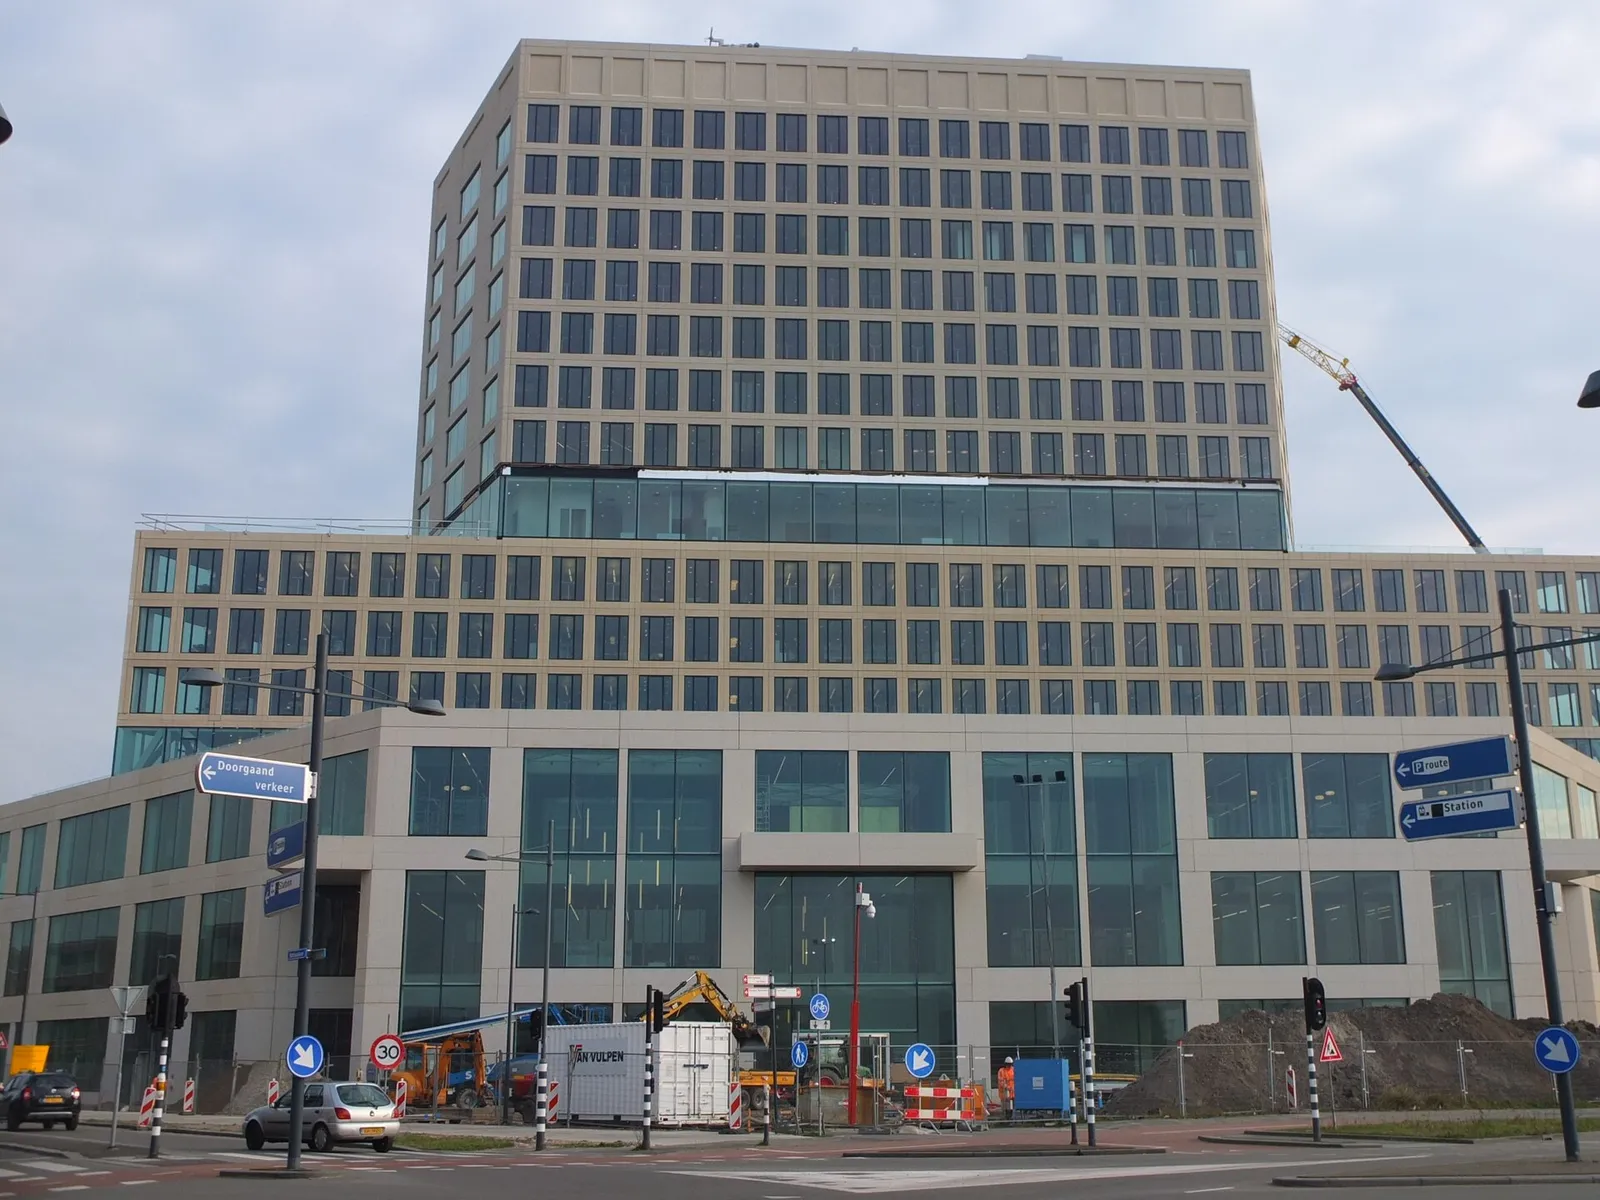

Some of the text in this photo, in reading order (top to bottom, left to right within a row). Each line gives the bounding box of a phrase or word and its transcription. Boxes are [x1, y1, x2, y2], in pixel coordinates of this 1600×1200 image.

[217, 760, 275, 777] Doorgaand
[1425, 759, 1448, 770] route
[255, 781, 295, 794] verkeer
[1444, 799, 1483, 812] Station
[377, 1045, 399, 1060] 30
[590, 1050, 624, 1063] VULPEN
